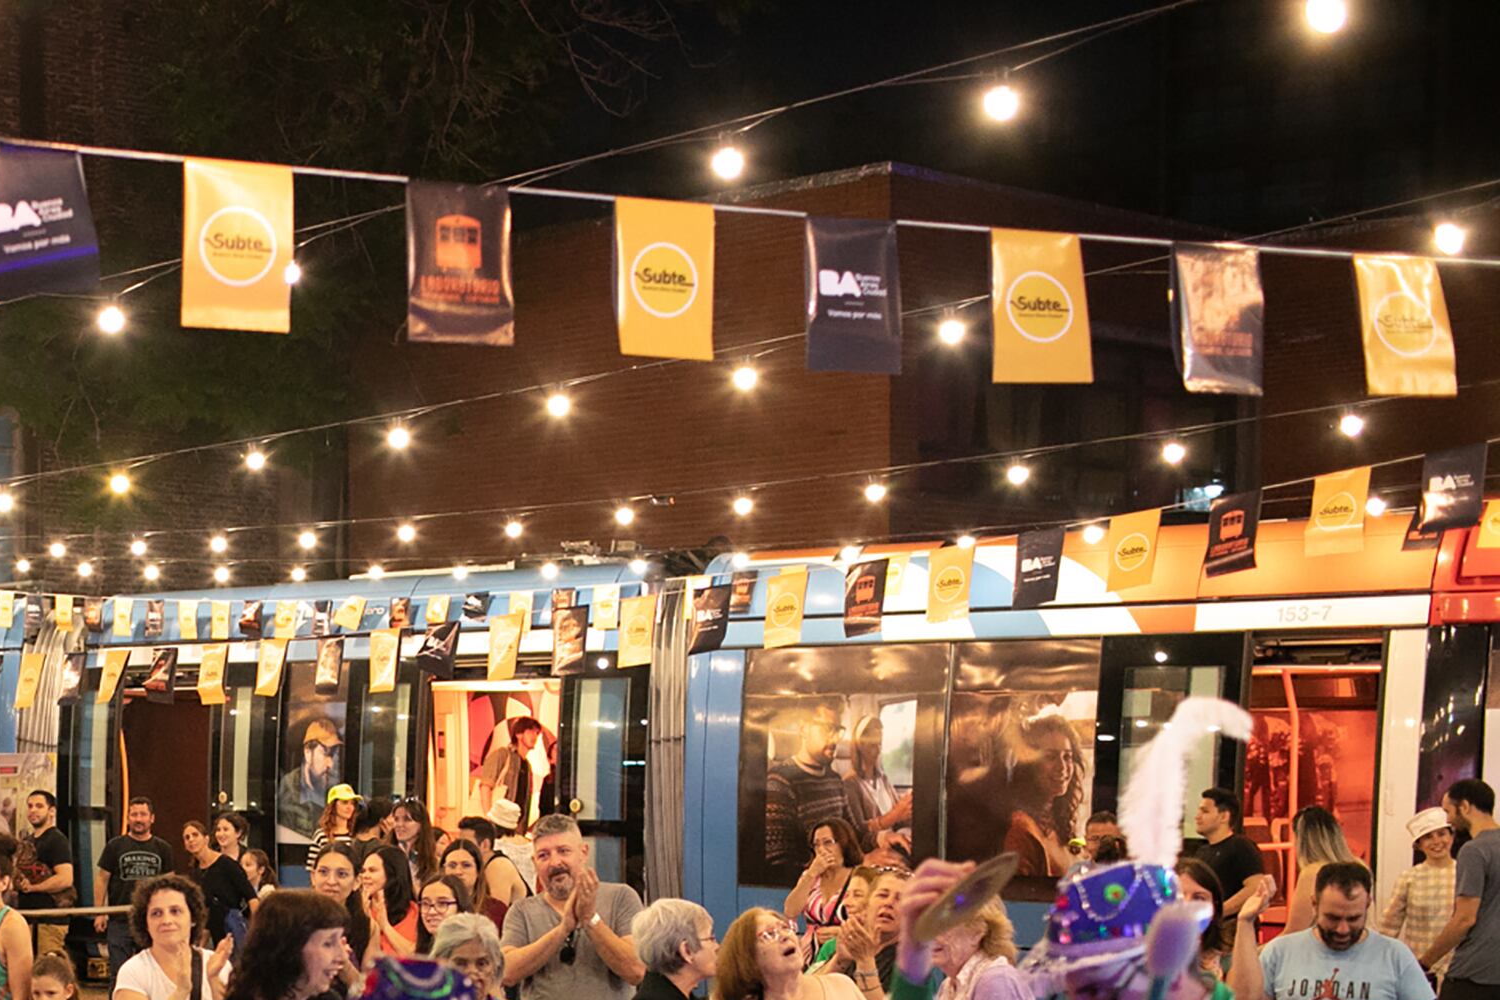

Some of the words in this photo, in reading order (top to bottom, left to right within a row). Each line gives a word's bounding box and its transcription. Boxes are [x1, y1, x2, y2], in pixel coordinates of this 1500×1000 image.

[209, 232, 268, 252] Subte
[639, 267, 690, 285] Subte
[818, 269, 862, 297] BA
[1014, 296, 1065, 312] Subte
[1322, 505, 1354, 517] Subte
[1276, 605, 1333, 623] 153-7
[124, 855, 157, 863] MAKING
[1287, 978, 1371, 1000] JORDAN
